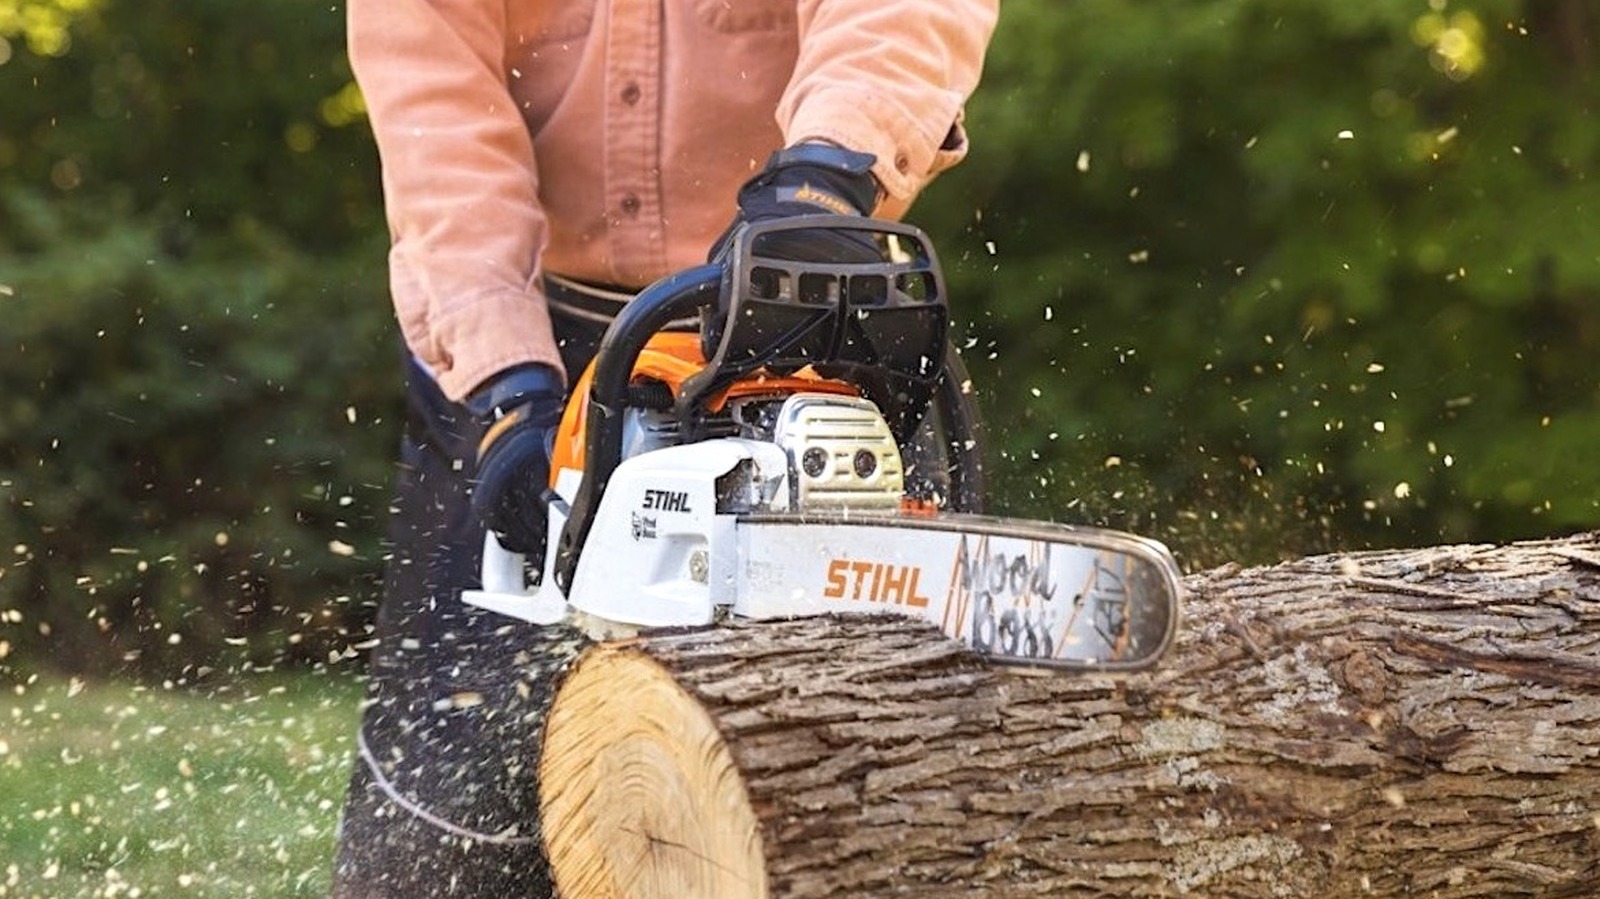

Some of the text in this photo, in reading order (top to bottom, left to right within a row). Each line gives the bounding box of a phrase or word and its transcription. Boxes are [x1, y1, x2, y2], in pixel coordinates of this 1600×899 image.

[642, 489, 692, 513] STIHL
[823, 560, 930, 608] STIHL
[961, 534, 1058, 601] Wood
